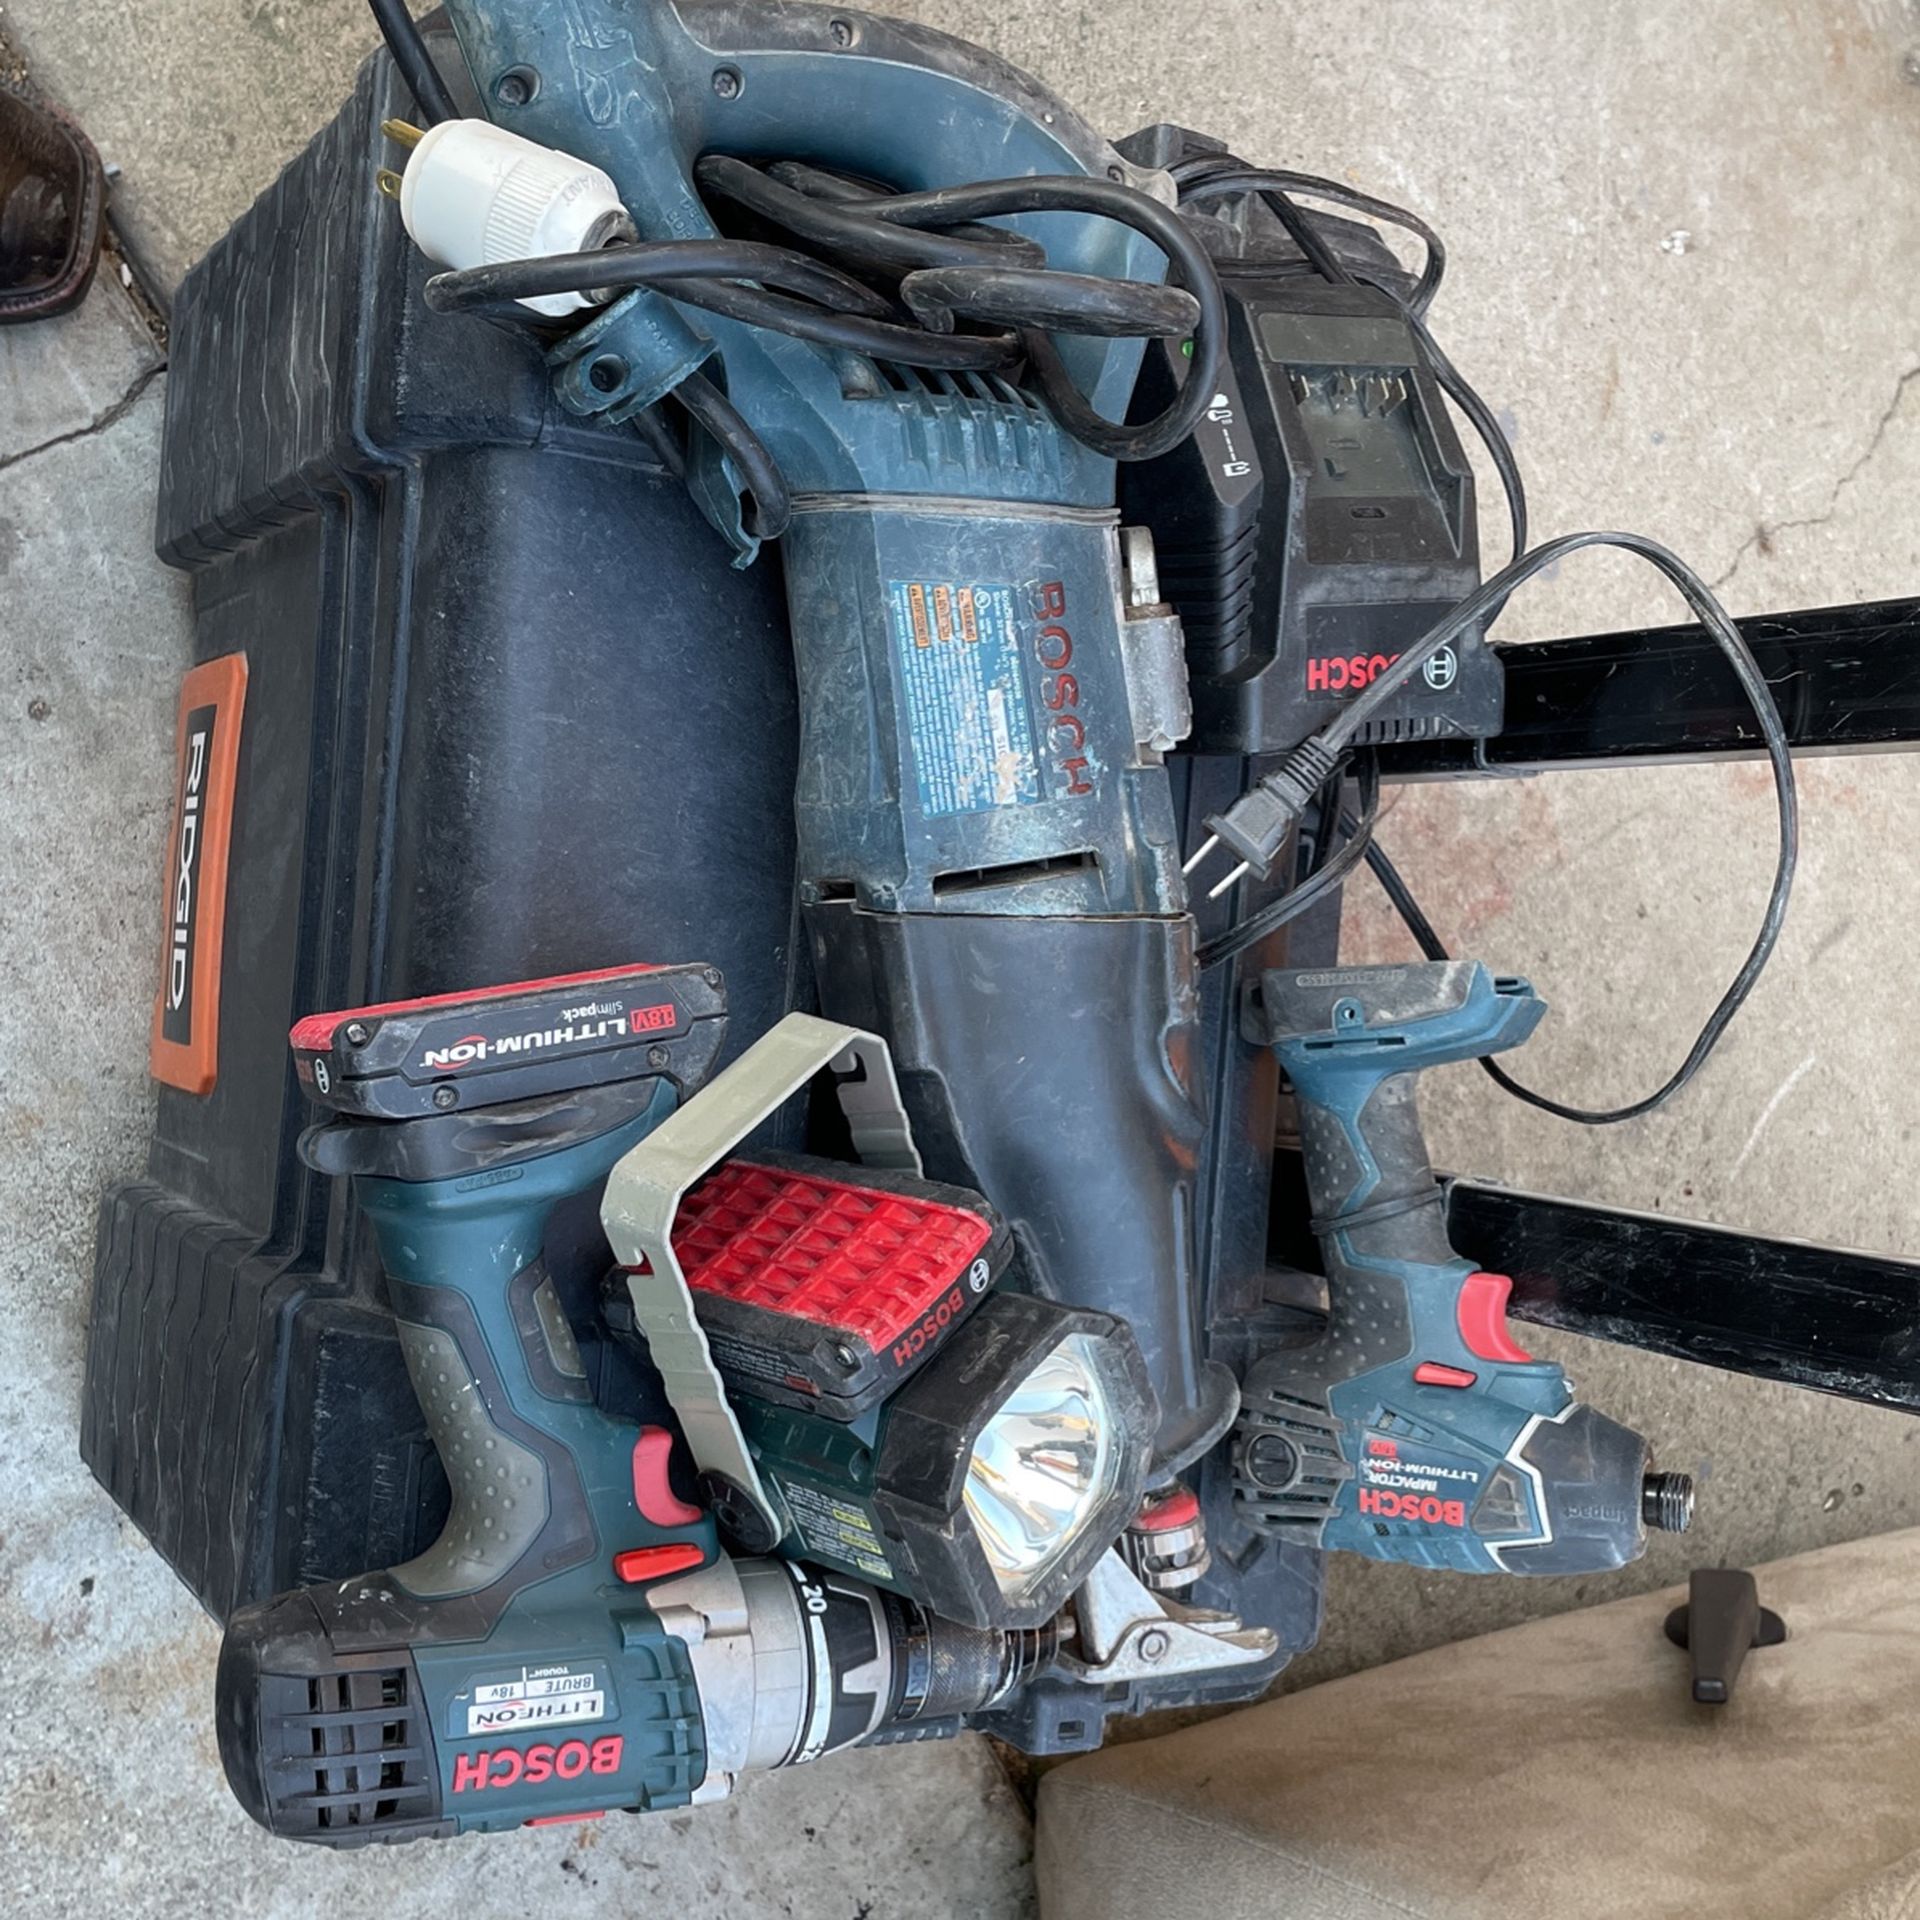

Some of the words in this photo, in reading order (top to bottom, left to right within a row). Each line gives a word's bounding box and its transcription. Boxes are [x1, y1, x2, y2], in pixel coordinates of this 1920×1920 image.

[1029, 580, 1094, 801] BOSCH
[1308, 652, 1409, 692] OSCH
[171, 731, 207, 1010] RIDGID
[562, 1000, 622, 1022] slimpack
[634, 1007, 674, 1031] 18V
[421, 1018, 627, 1069] LITHIUM-ION
[892, 1289, 965, 1368] BOSCH
[1368, 1471, 1437, 1491] IMPACTOR
[1358, 1488, 1465, 1527] BOSCH
[802, 1583, 828, 1613] 20
[545, 1676, 592, 1693] BRUTE
[452, 1735, 624, 1793] BOSCH
